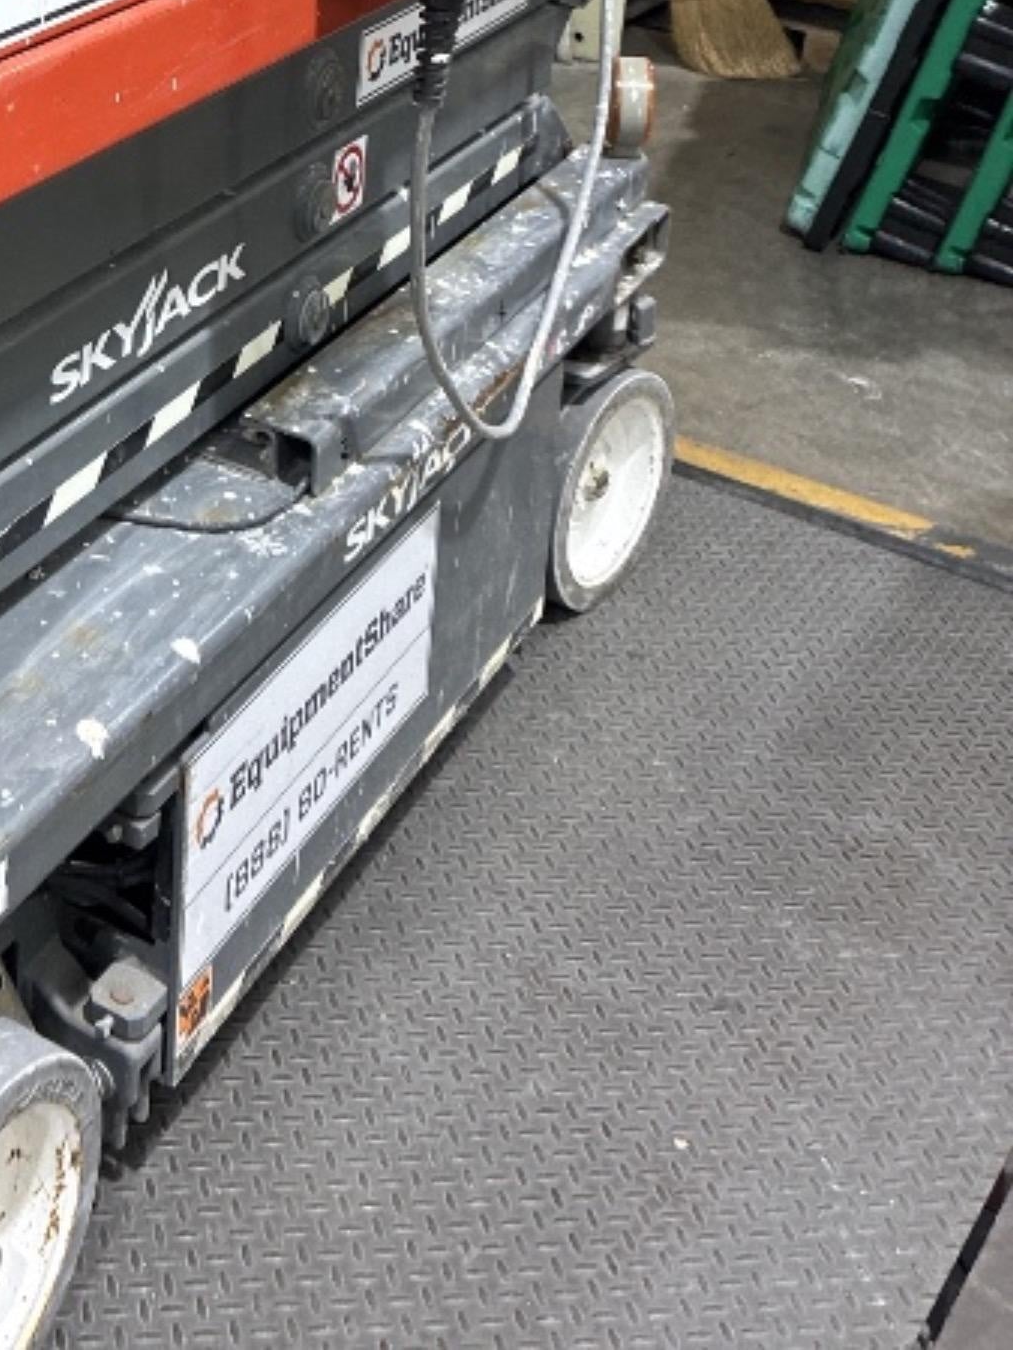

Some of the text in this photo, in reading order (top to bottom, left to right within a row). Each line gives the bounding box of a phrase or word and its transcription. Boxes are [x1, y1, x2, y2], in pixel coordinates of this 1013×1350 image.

[49, 243, 246, 405] SKYJACK
[230, 572, 425, 810] EquipmentShare
[298, 683, 398, 822] 80-RENTS
